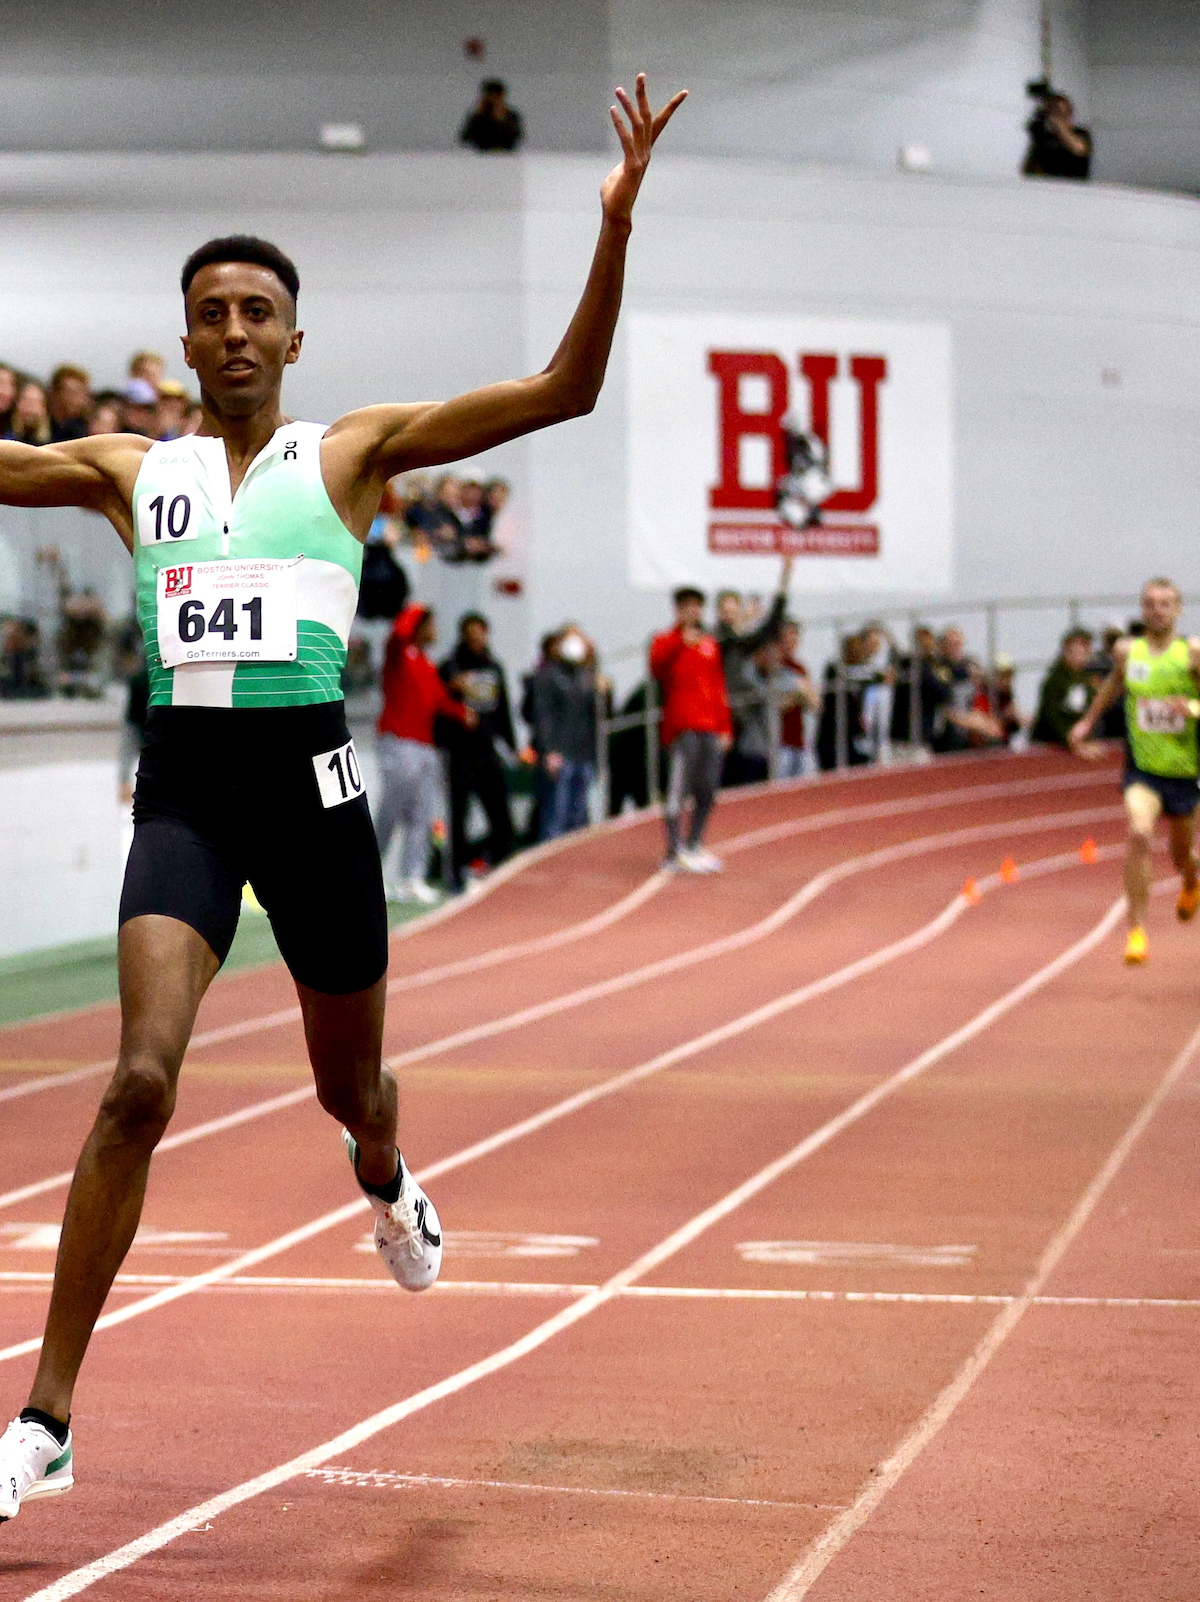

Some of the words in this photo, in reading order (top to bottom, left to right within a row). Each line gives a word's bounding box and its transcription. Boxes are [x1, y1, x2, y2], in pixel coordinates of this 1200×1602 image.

[708, 351, 886, 511] BU
[148, 494, 191, 540] 10
[165, 566, 193, 592] BU
[197, 566, 232, 574] BOSTON
[234, 564, 284, 572] UNIVERSITY
[178, 597, 262, 643] 641
[187, 650, 260, 659] GoTerriers.com
[328, 745, 361, 799] 10
